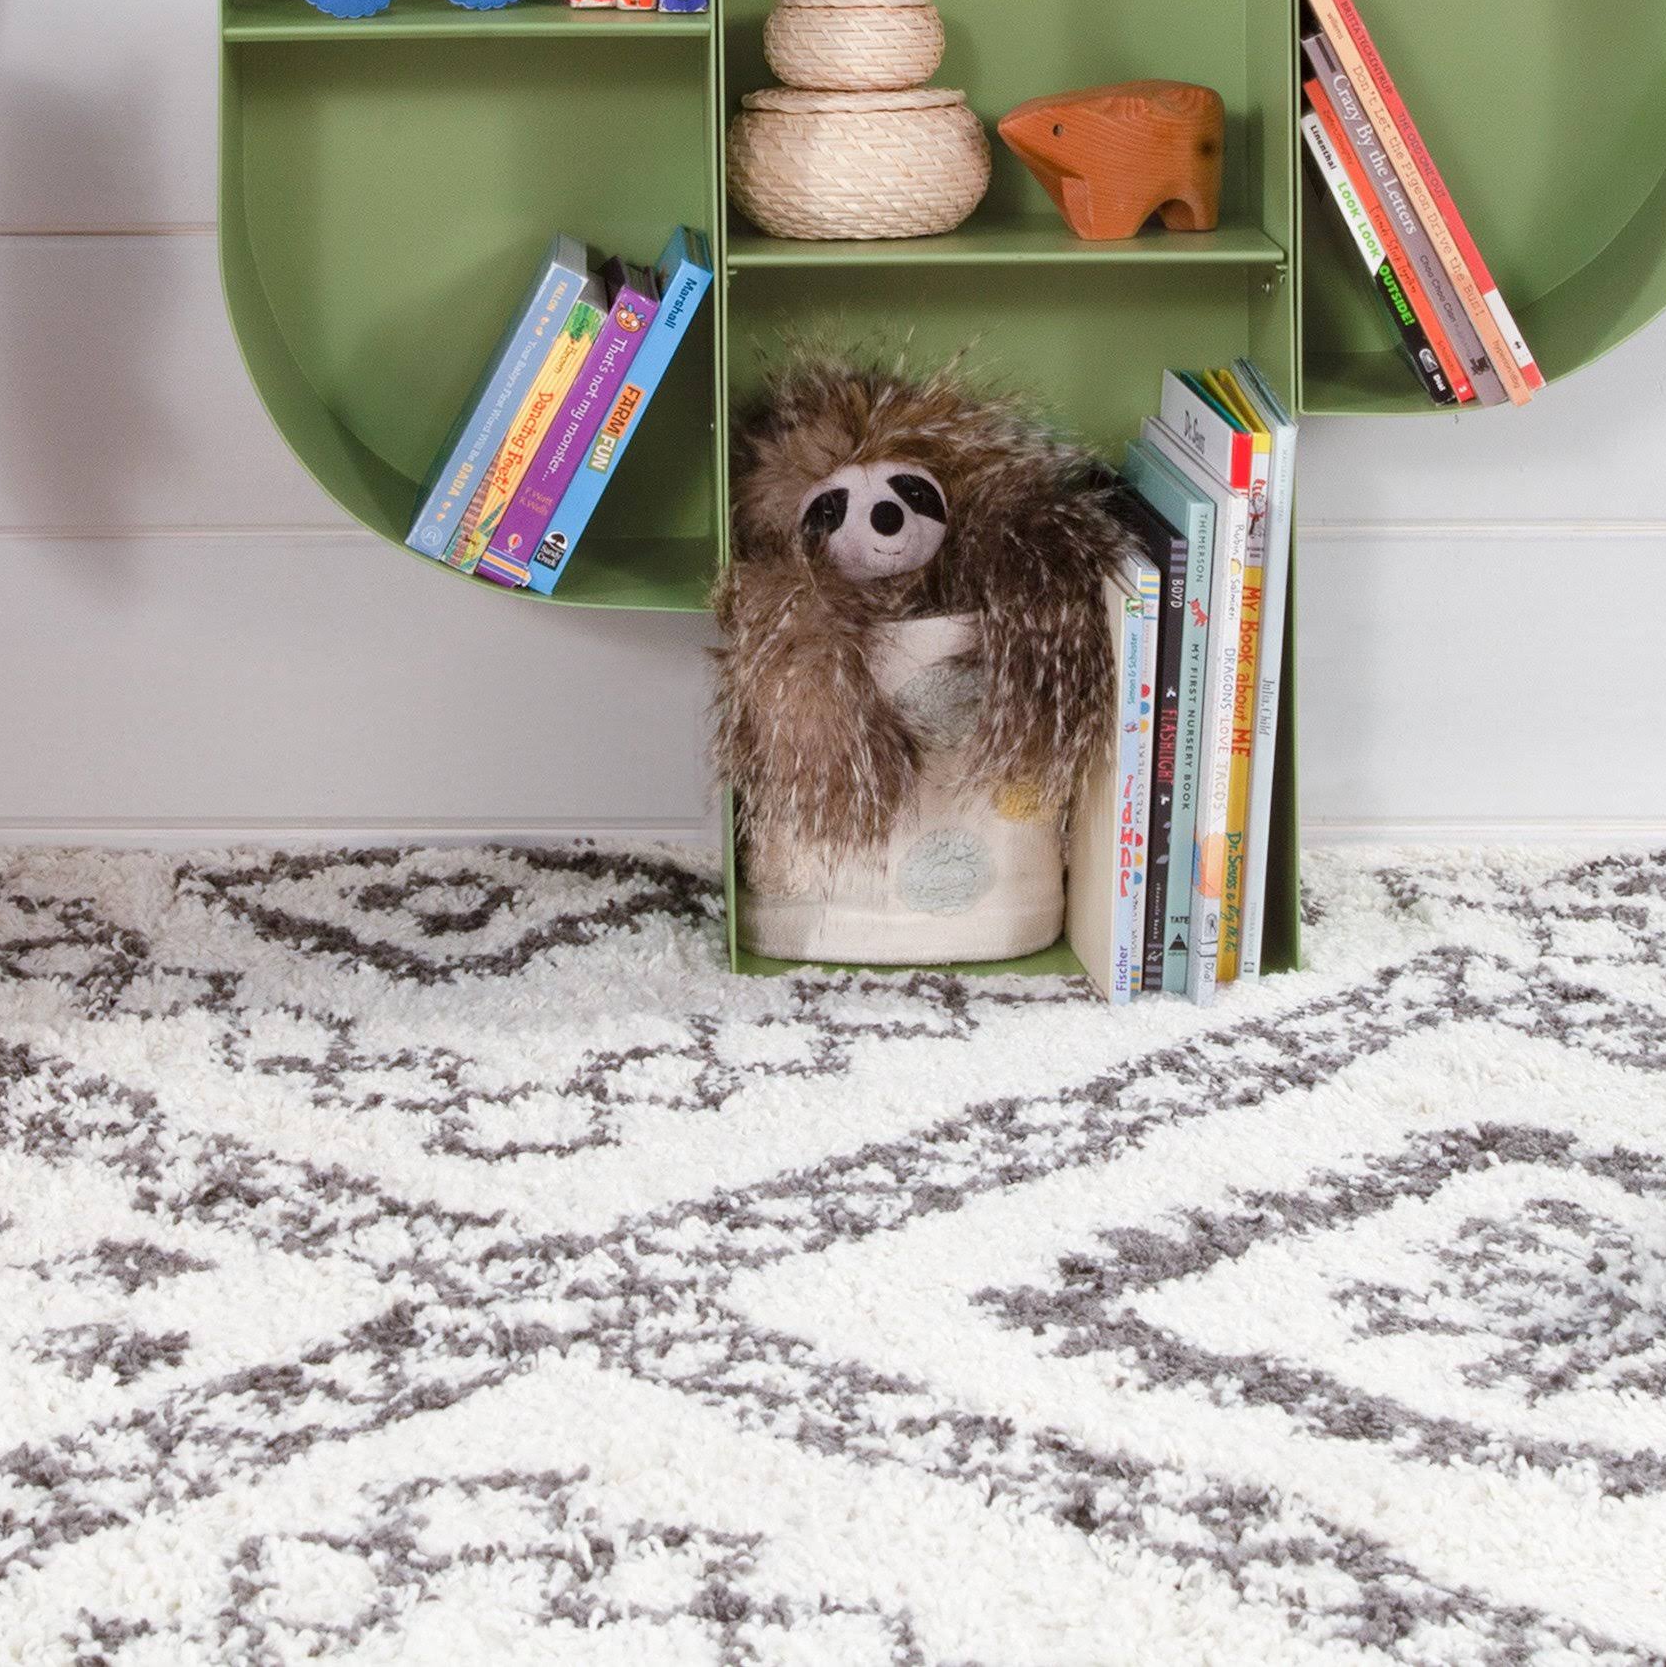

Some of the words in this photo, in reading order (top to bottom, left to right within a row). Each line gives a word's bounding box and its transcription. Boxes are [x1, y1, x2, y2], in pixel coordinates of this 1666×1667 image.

[1310, 124, 1337, 170] Linenthal
[1333, 73, 1362, 122] Crazy
[1356, 123, 1375, 147] By
[1369, 150, 1389, 178] the
[1383, 177, 1418, 235] Letters
[1352, 66, 1378, 106] Don't
[1374, 109, 1391, 132] Let
[1388, 136, 1405, 159] the
[1401, 163, 1431, 209] Pigeon
[1427, 213, 1453, 255] Drive
[1449, 256, 1466, 282] the
[1336, 181, 1362, 219] LOOK
[1357, 221, 1382, 260] LOOK
[1379, 264, 1416, 327] OUTSIDE!
[664, 277, 698, 330] Marshall
[599, 336, 629, 374] That's
[585, 374, 604, 399] not
[511, 390, 555, 450] Dancing
[570, 399, 592, 421] my
[606, 385, 642, 435] FARM
[541, 421, 580, 482] monster...
[591, 434, 617, 471] FUN
[448, 462, 475, 498] DADA
[493, 450, 525, 495] Feet!
[1195, 513, 1209, 583] THEMERSON
[1232, 524, 1246, 555] Rubin
[1171, 579, 1184, 609] BOYD
[1241, 586, 1261, 612] MY
[1190, 643, 1200, 662] MY
[1188, 667, 1199, 704] FIRST
[1219, 647, 1236, 710] DRAGONS
[1185, 709, 1196, 768] NURSERY
[1216, 717, 1231, 752] LOVE
[1231, 727, 1252, 758] ME
[1258, 707, 1273, 737] Child
[1158, 708, 1178, 784] FLASHLIGHT
[1181, 774, 1192, 811] BOOK
[1212, 761, 1229, 811] TACOS
[1170, 916, 1190, 925] TATE
[1115, 945, 1129, 992] Fischer
